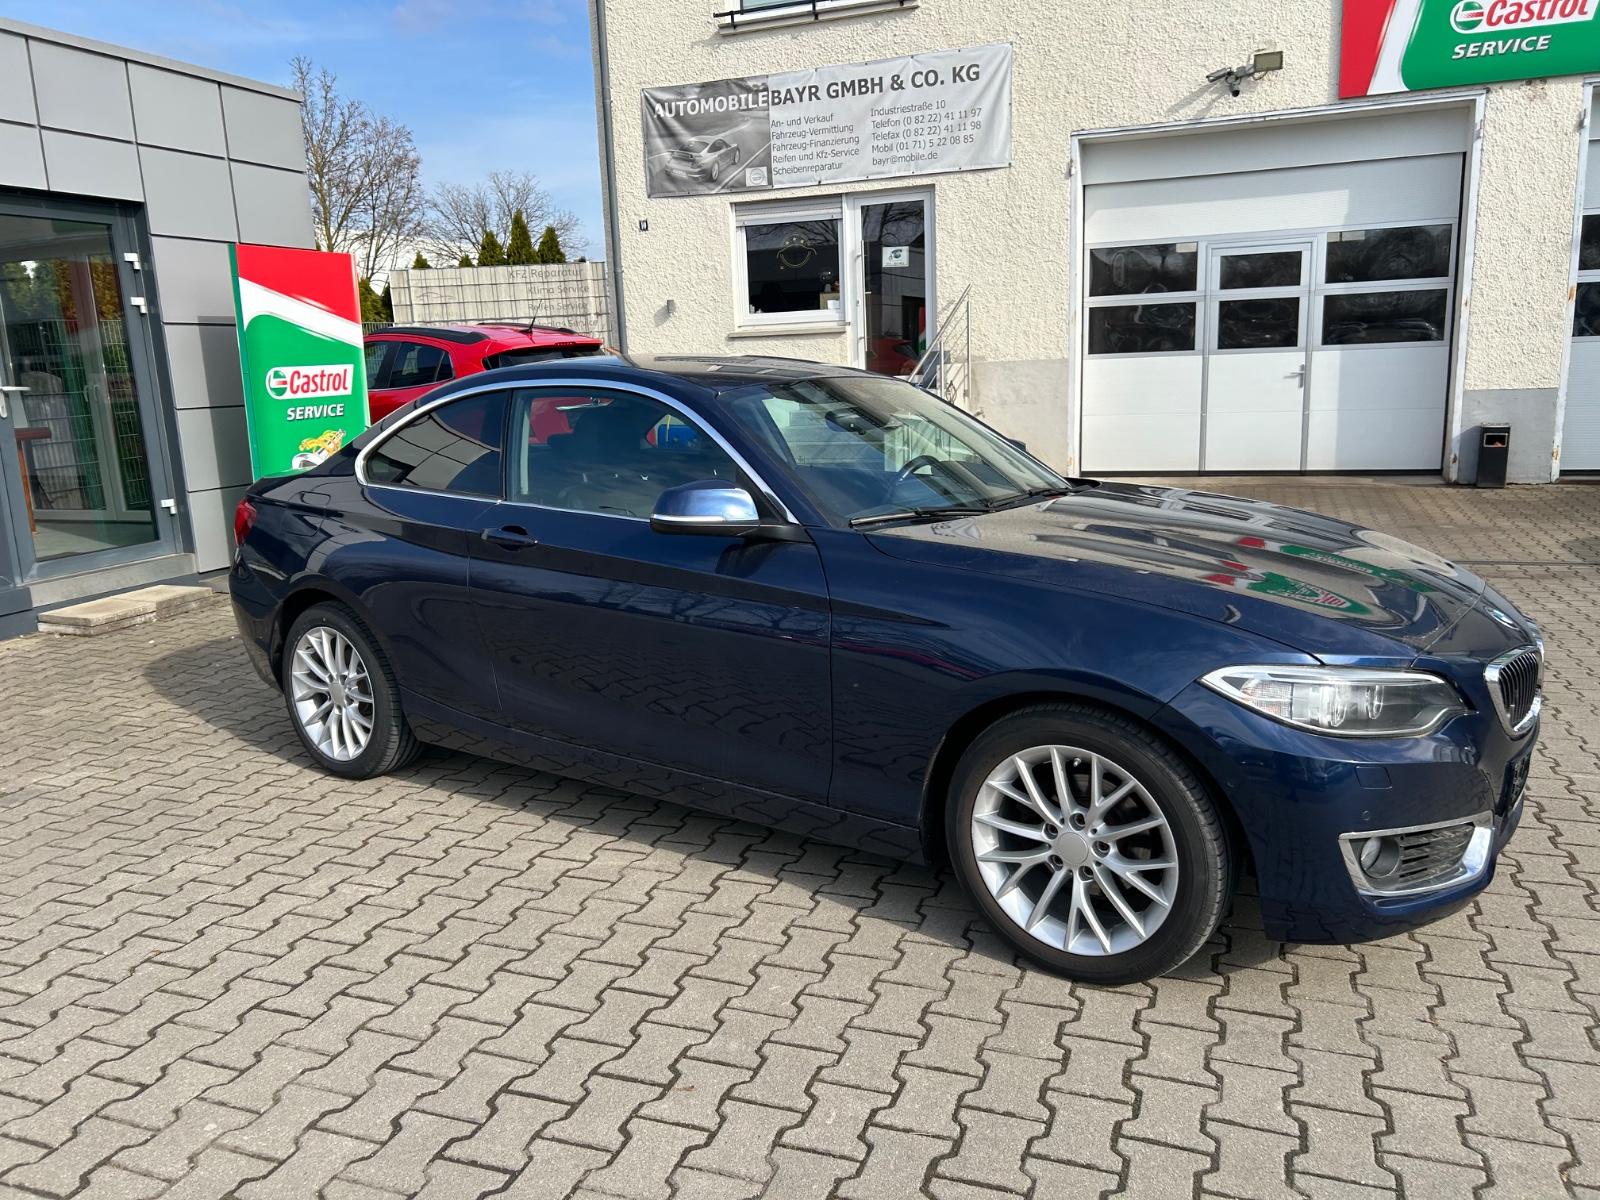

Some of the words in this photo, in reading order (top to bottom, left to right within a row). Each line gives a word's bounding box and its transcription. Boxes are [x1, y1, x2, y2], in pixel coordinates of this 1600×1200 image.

[1486, 0, 1588, 26] Castrol
[1452, 35, 1552, 59] SERVICE
[654, 91, 768, 118] AUTOMOBILE
[771, 84, 821, 106] BAYR
[826, 76, 883, 98] GMBH
[890, 74, 905, 91] &
[911, 69, 945, 88] CO.
[952, 64, 980, 84] KG
[871, 101, 933, 117] Industriestraße
[936, 100, 946, 110] 10
[771, 119, 784, 128] An-
[787, 117, 801, 126] und
[804, 113, 834, 124] Verkauf
[872, 118, 900, 129] Telefon
[903, 116, 911, 127] (0
[914, 115, 925, 125] 82
[927, 113, 942, 123] 22)
[944, 111, 954, 120] 41
[958, 110, 967, 119] 11
[970, 108, 982, 117] 97
[771, 124, 854, 140] Fahrzeug-Vermittlung
[872, 130, 900, 141] Telefax
[902, 128, 911, 139] (0
[914, 127, 925, 137] 82
[927, 125, 941, 136] 22)
[944, 124, 954, 133] 41
[957, 122, 967, 131] 11
[970, 121, 982, 131] 98
[772, 136, 860, 152] Fahrzeug-Finanzierung
[872, 143, 894, 153] Mobil
[896, 141, 909, 153] (01
[912, 139, 926, 150] 71)
[929, 138, 934, 148] 5
[936, 137, 947, 147] 22
[949, 135, 961, 145] 08
[963, 134, 974, 144] 85
[772, 154, 796, 163] Reifen
[799, 152, 814, 161] und
[816, 148, 860, 159] Kfz-Service
[872, 151, 938, 167] bayr@mobile.de
[773, 162, 843, 175] Scheibenreparatur
[508, 269, 526, 279] KFZ
[531, 268, 583, 280] Reparatur
[528, 286, 555, 295] Klima
[558, 285, 590, 294] Service
[557, 302, 589, 311] Service
[289, 368, 349, 395] Castrol
[286, 403, 345, 421] SERVICE
